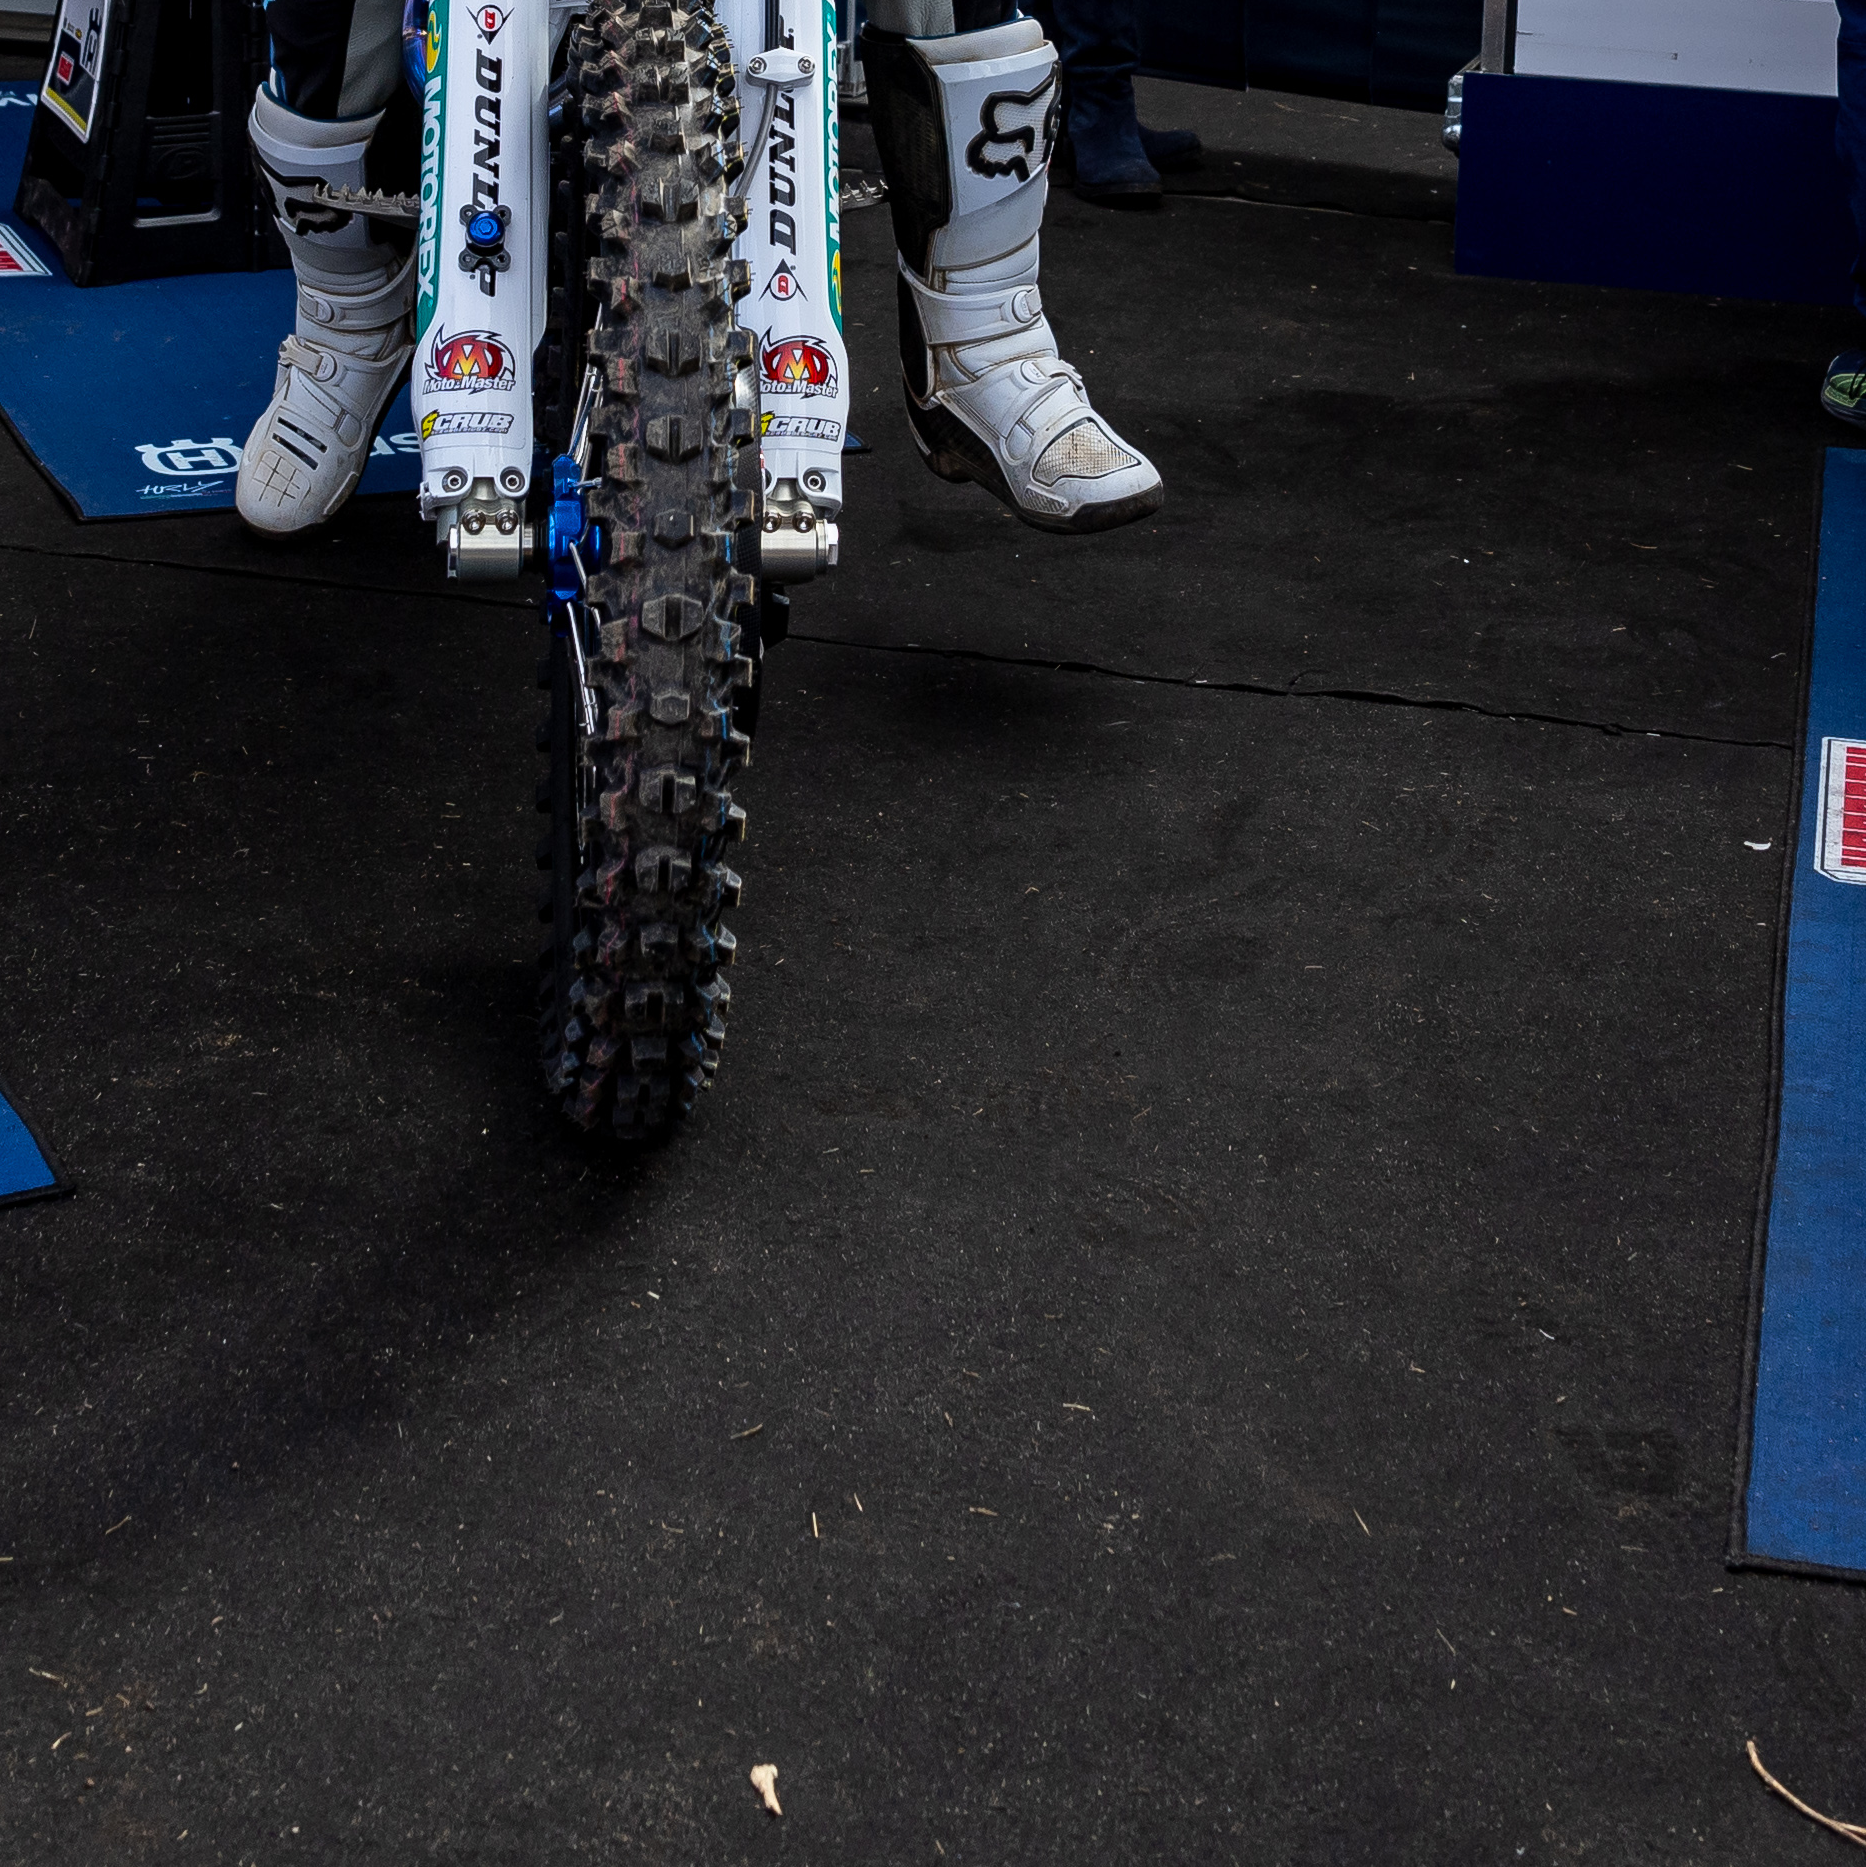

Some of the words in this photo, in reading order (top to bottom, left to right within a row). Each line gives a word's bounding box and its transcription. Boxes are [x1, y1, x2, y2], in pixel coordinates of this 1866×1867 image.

[416, 74, 442, 302] MOTOREX
[472, 47, 503, 298] DUNLP
[768, 14, 797, 257] DUNLP
[421, 409, 515, 438] SCRUB
